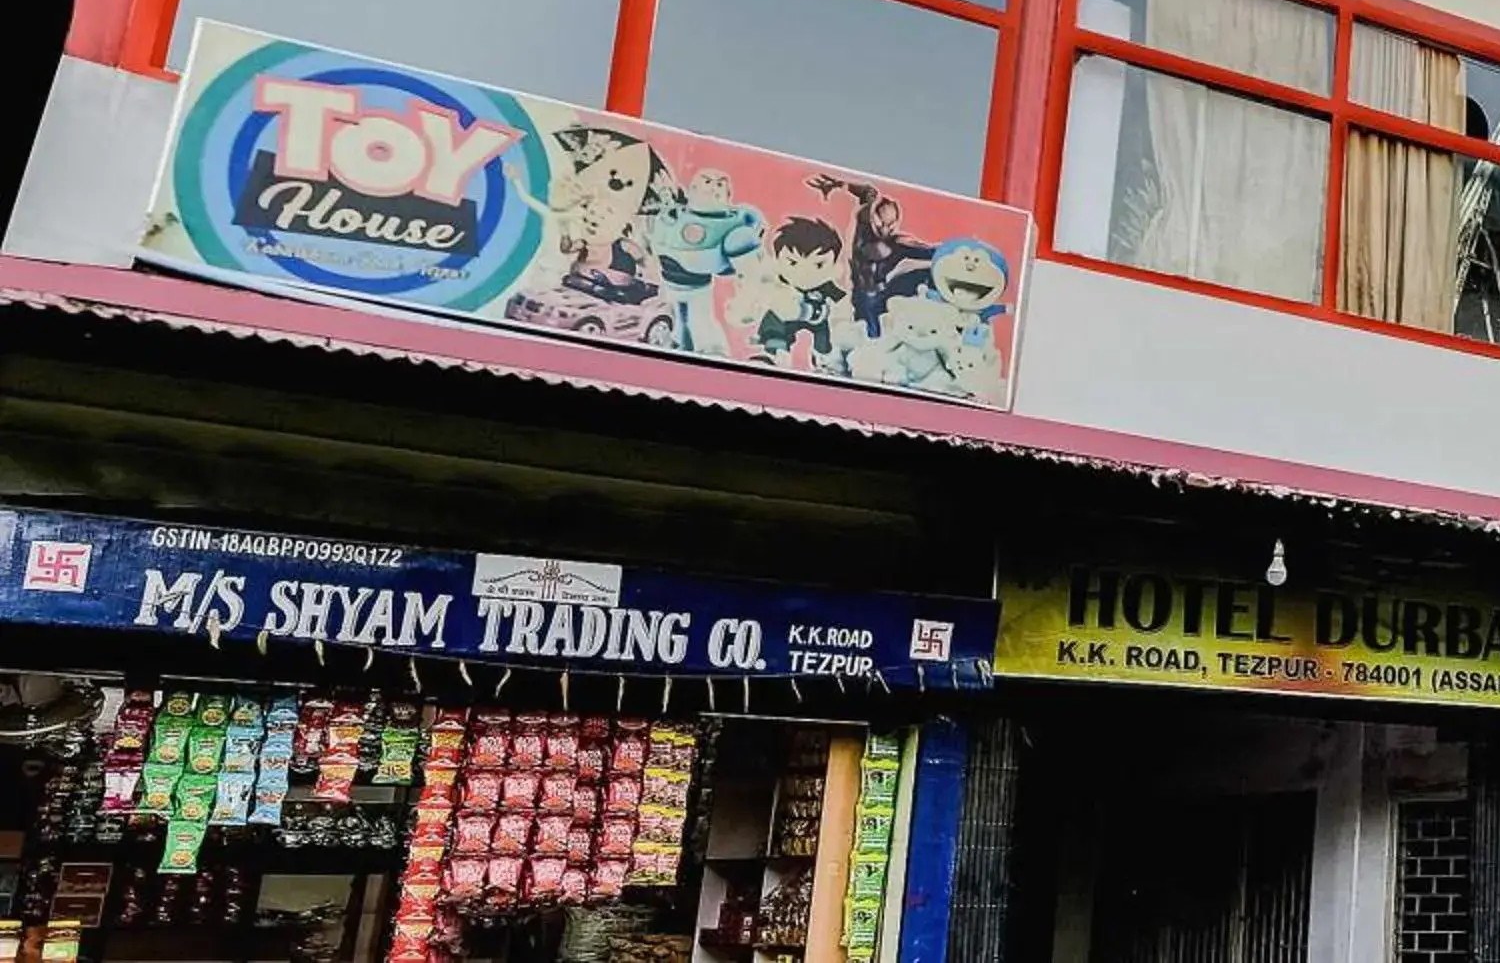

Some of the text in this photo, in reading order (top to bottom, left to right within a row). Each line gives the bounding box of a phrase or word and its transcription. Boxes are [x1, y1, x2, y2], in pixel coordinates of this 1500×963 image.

[257, 75, 526, 206] TOY
[257, 181, 466, 248] House
[133, 568, 767, 670] M/S SHYAM TRADING CO.
[1067, 565, 1292, 644] HOTEL
[788, 650, 873, 677] TEZPUR
[1056, 640, 1115, 666] K.K.
[1125, 646, 1207, 677] ROAD,
[1217, 653, 1318, 681] TEZPUR
[1342, 662, 1423, 690] 784001
